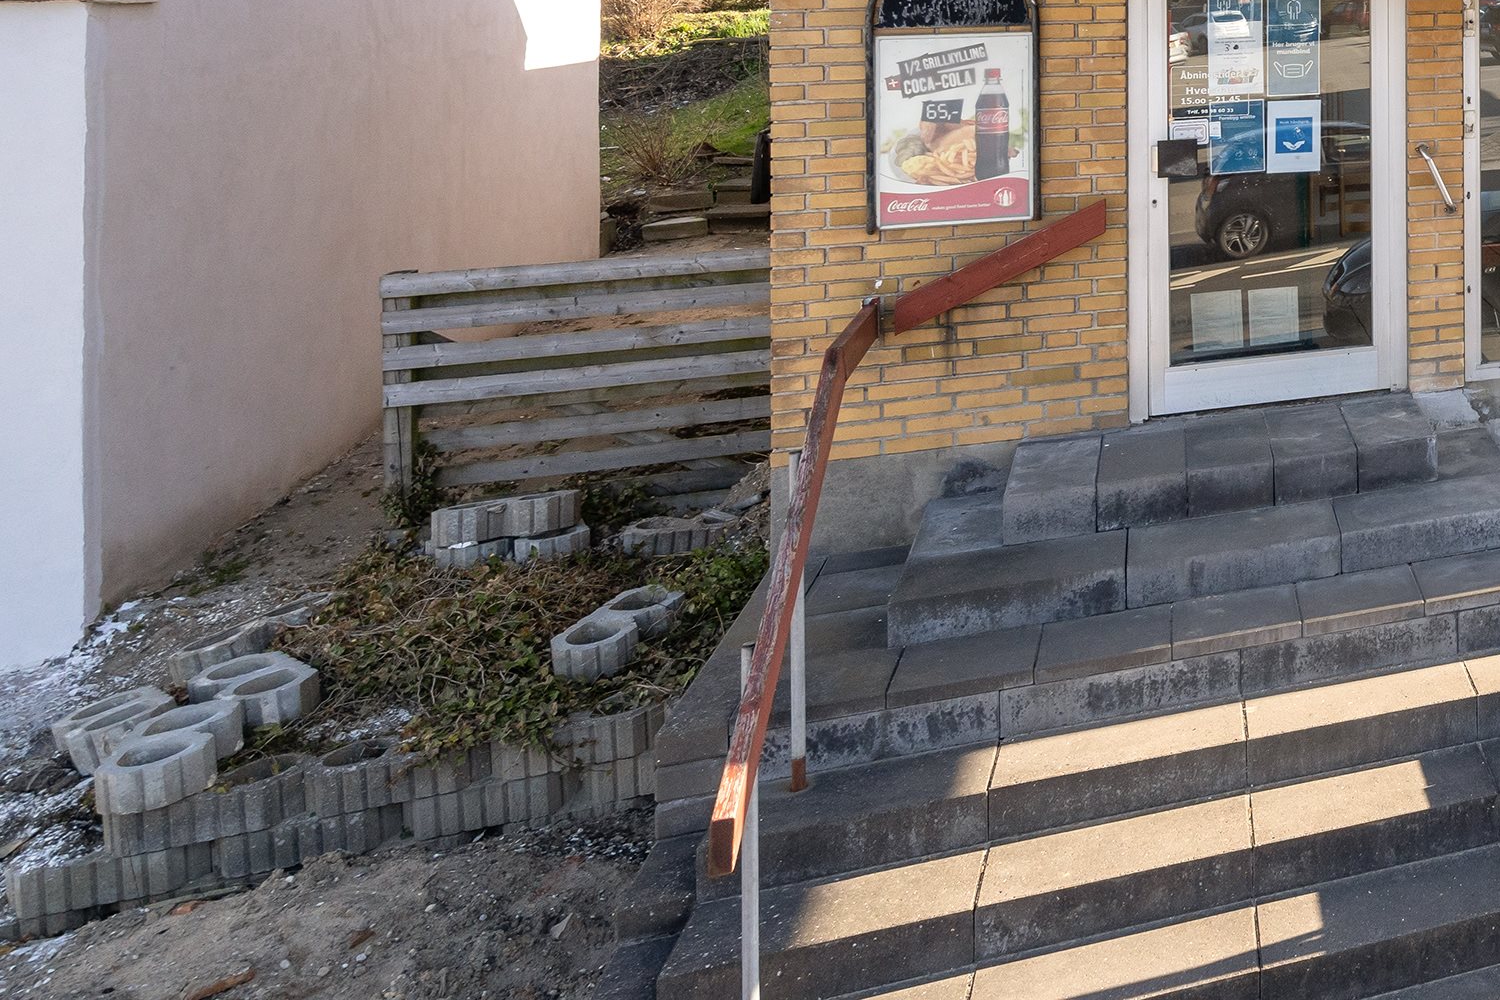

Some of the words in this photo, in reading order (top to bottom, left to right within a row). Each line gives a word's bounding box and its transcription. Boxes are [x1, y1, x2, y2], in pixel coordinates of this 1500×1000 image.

[1276, 47, 1311, 55] mundbind
[904, 61, 922, 76] 1/2
[922, 46, 986, 71] GRILLKYLLING
[903, 70, 973, 95] COCA-COLA
[1215, 95, 1241, 103] 21.45
[926, 103, 959, 120] 65,-
